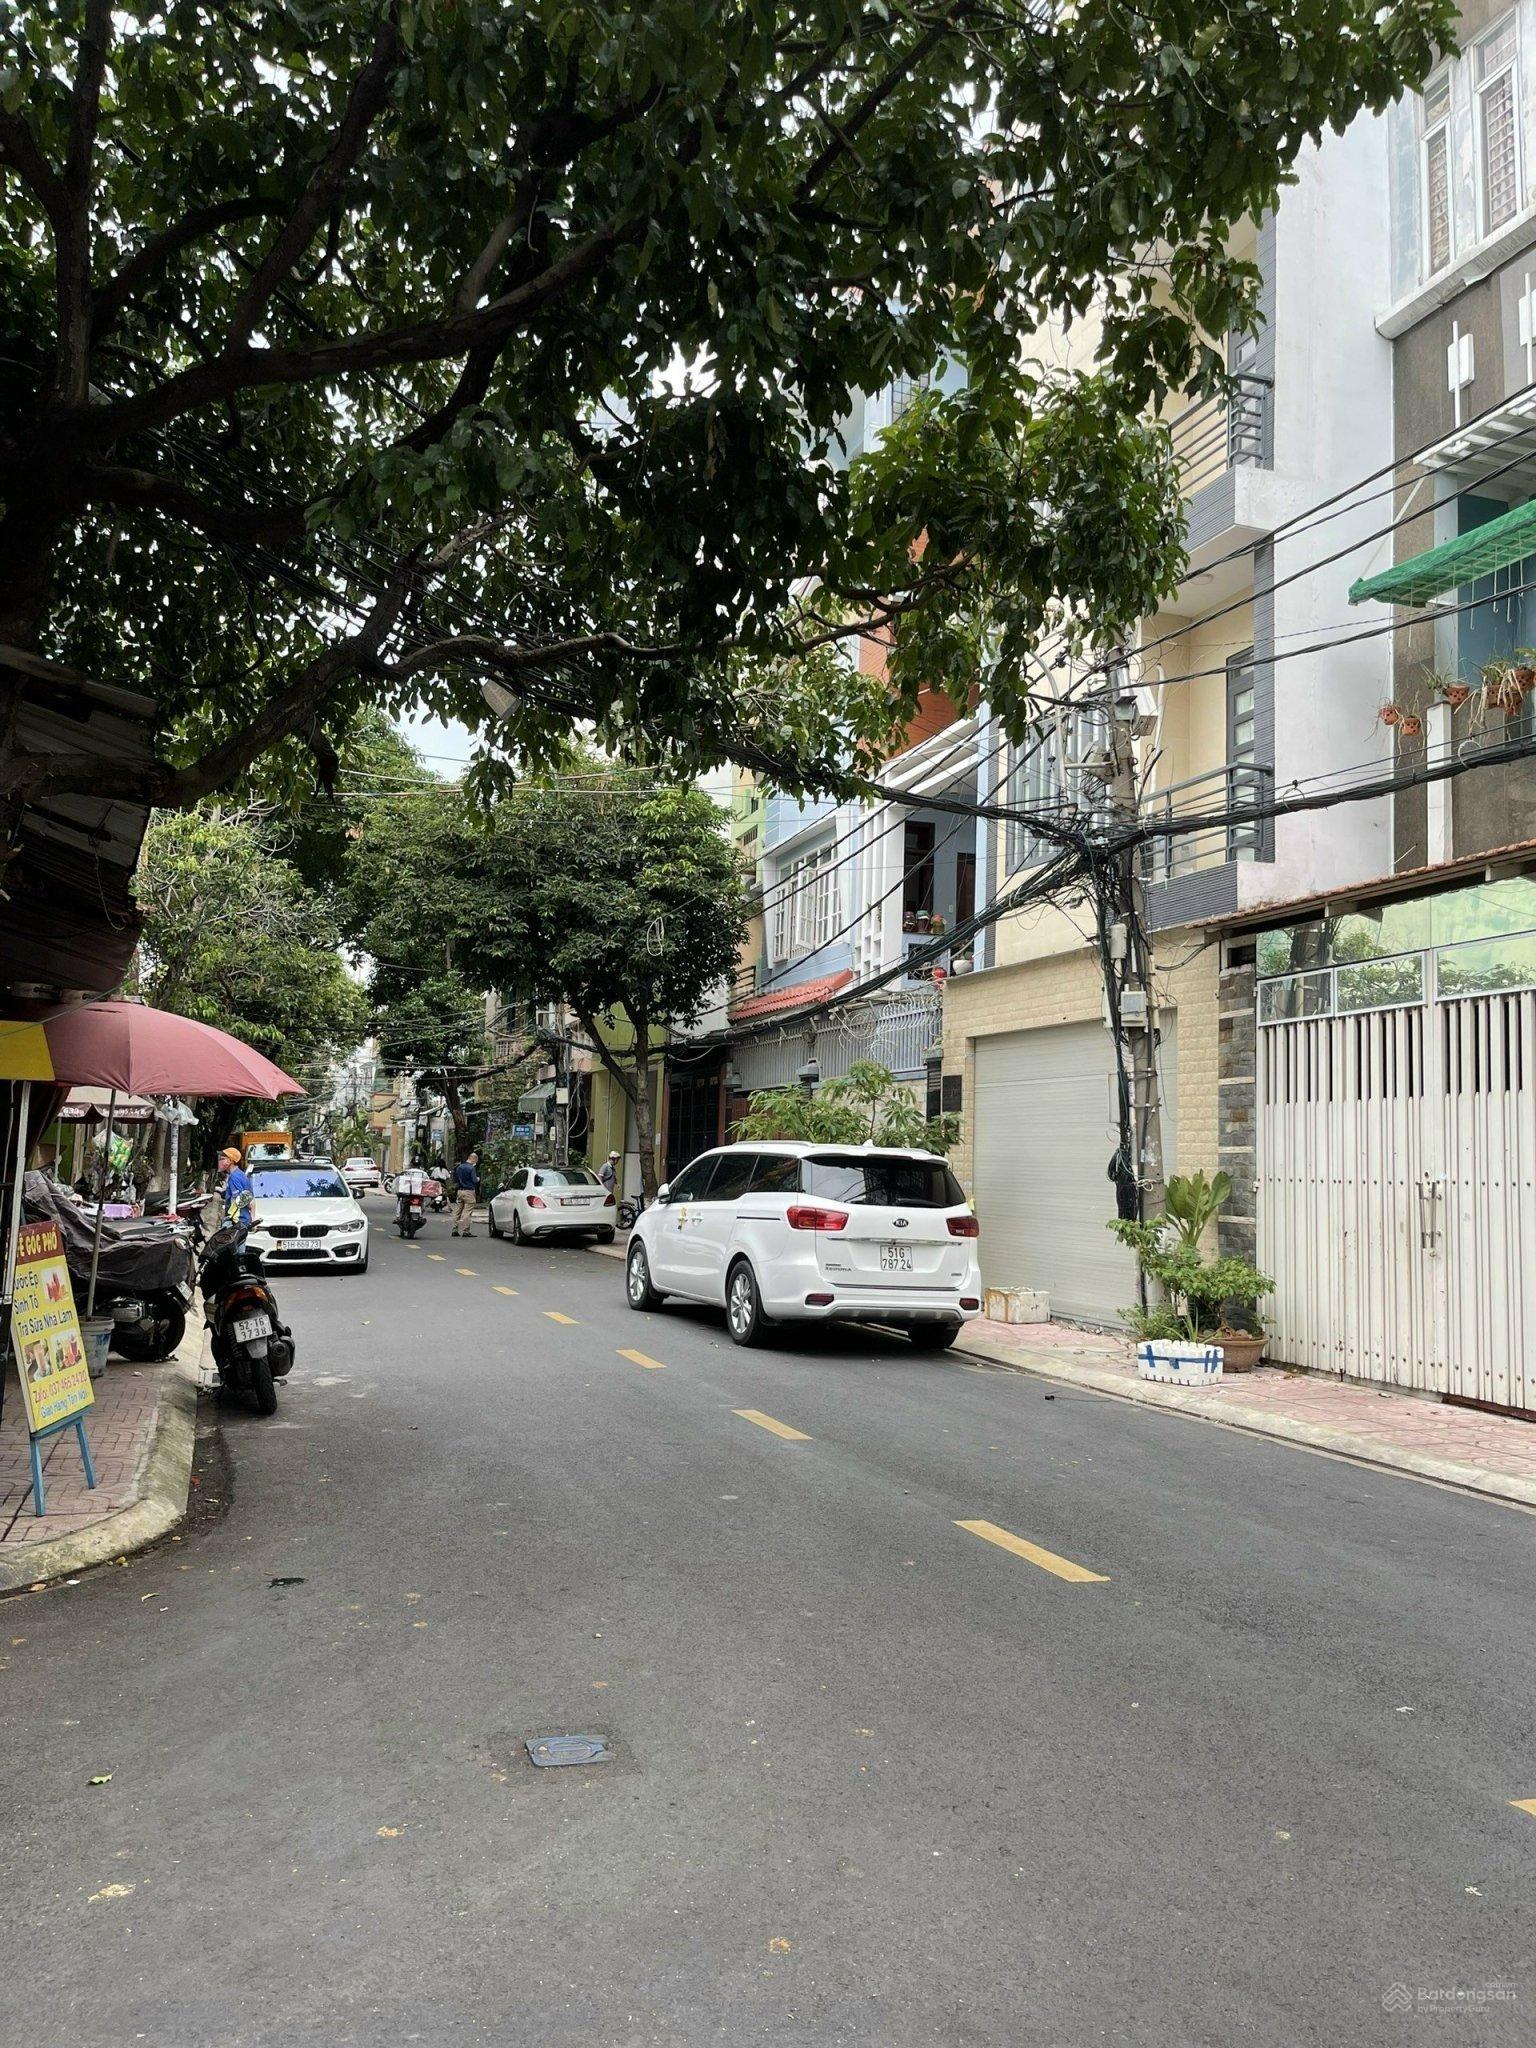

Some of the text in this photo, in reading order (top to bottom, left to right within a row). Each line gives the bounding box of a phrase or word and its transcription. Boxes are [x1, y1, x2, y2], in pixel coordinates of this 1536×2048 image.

[26, 1230, 41, 1256] GÓC
[887, 1247, 905, 1258] 51G
[14, 1296, 29, 1314] Sinh
[240, 1326, 267, 1341] 3738
